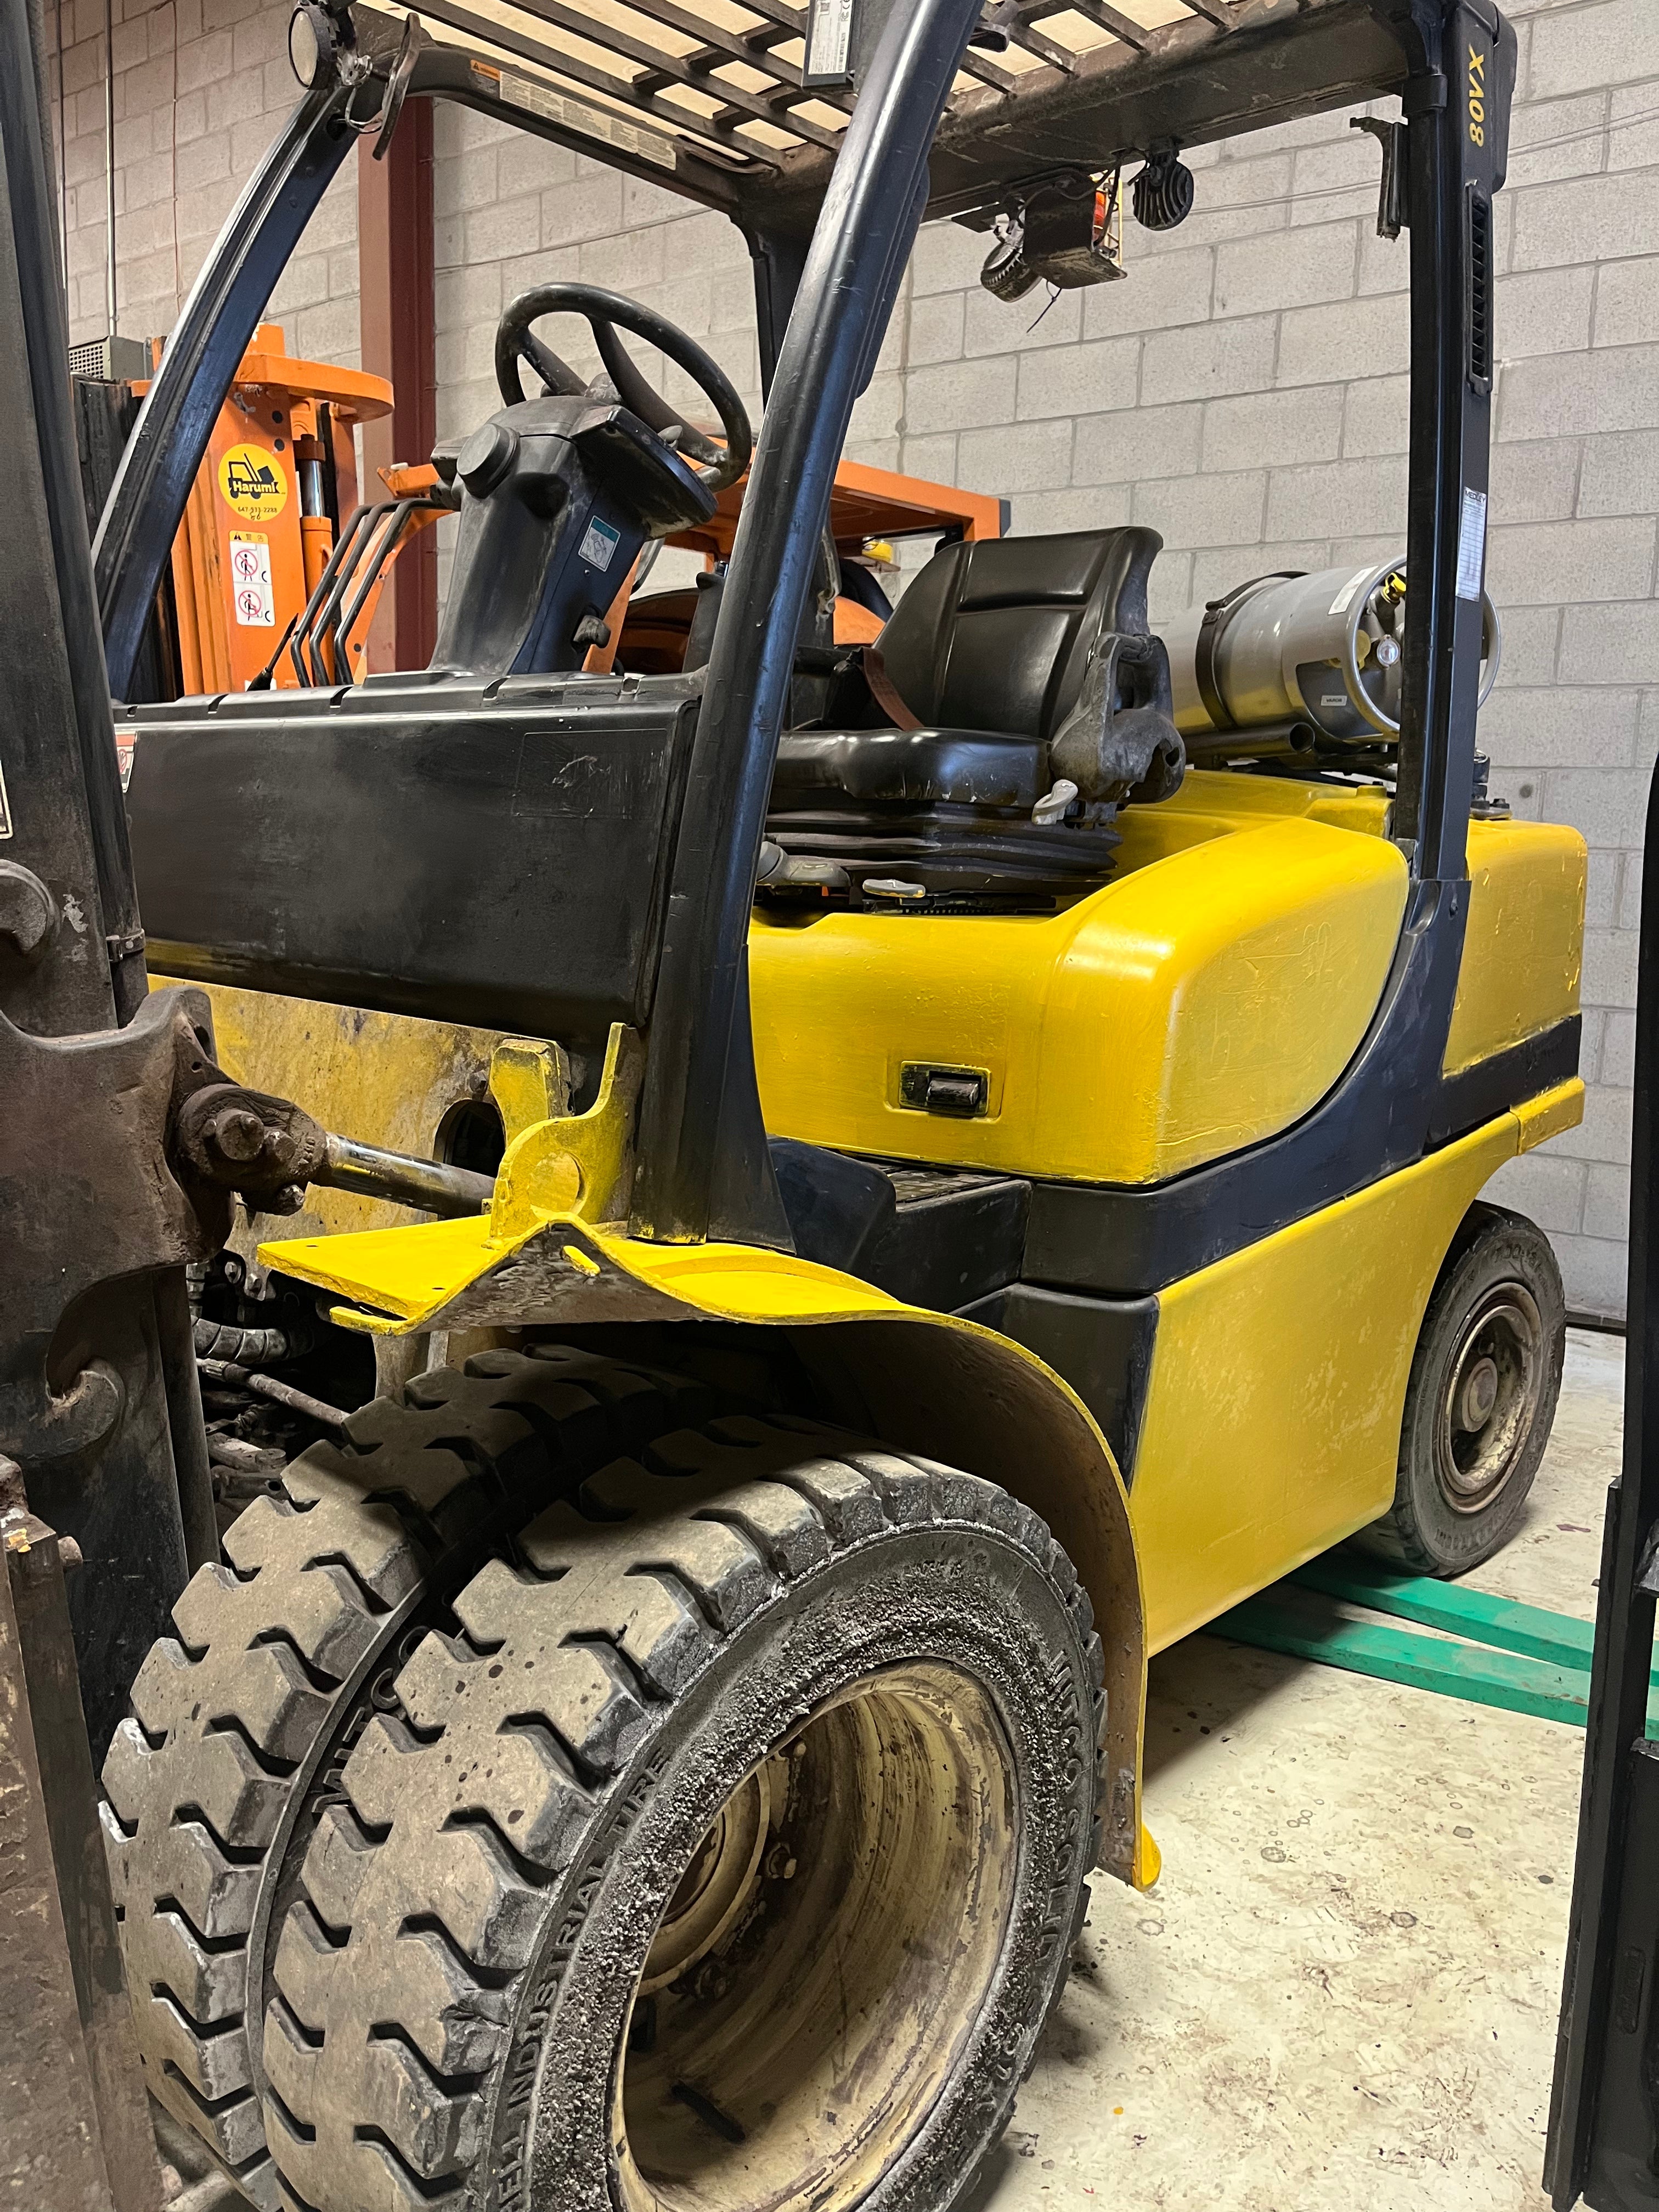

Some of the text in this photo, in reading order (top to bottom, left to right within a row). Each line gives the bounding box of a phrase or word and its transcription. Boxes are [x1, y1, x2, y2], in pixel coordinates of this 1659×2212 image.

[233, 481, 275, 493] Harumi
[1465, 490, 1486, 503] MEDLEY
[506, 1853, 605, 2117] INDUSTRIAL
[605, 1746, 670, 1837] TIRE
